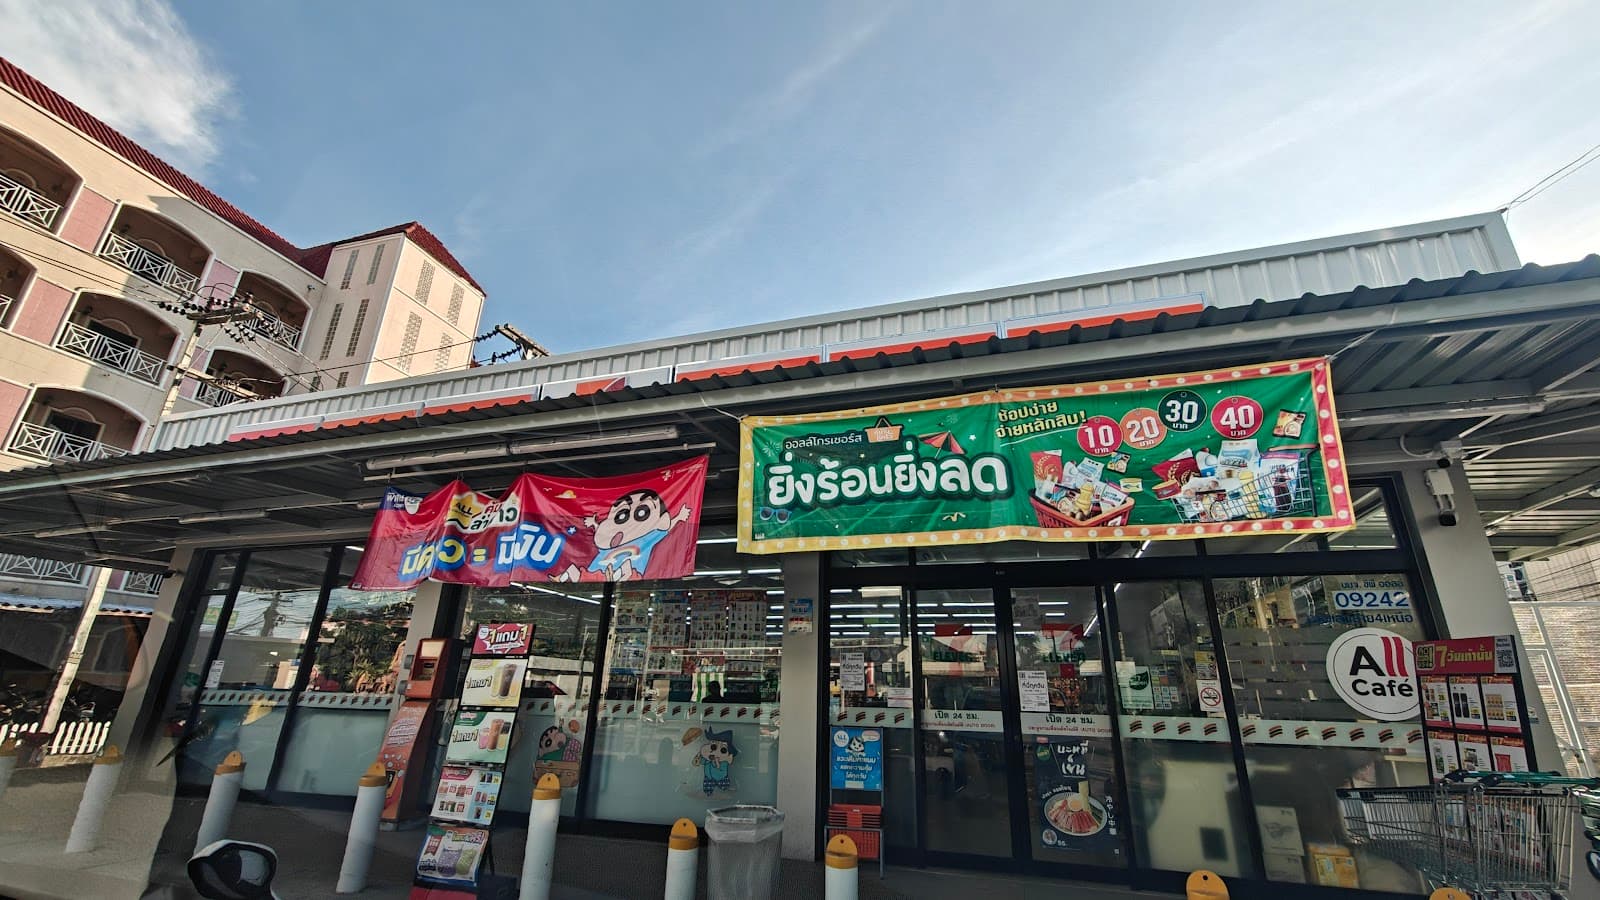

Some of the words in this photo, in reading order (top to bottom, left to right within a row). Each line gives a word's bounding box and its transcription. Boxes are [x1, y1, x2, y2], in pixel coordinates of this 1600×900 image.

[998, 401, 1058, 422] ช้อปง่าย
[1166, 399, 1199, 423] 30
[1219, 405, 1256, 430] 40
[995, 410, 1087, 438] จ่ายหลักสิบ!
[1126, 414, 1161, 441] 20
[1172, 421, 1188, 430] บาท
[1230, 428, 1247, 437] บาท
[1083, 424, 1115, 448] 10
[1139, 437, 1154, 447] บาท
[1094, 446, 1109, 454] บาท
[768, 440, 1009, 506] ยิ่งร้อนยิ่งลด
[1335, 591, 1410, 608] 09242
[489, 625, 528, 645] 1แถม1
[1349, 636, 1409, 677] All
[1351, 678, 1413, 697] Café
[934, 710, 950, 720] เปิด
[952, 712, 963, 720] 24
[1045, 713, 1062, 723] เปิด
[1066, 716, 1077, 724] 24
[1080, 717, 1096, 725] ชม.
